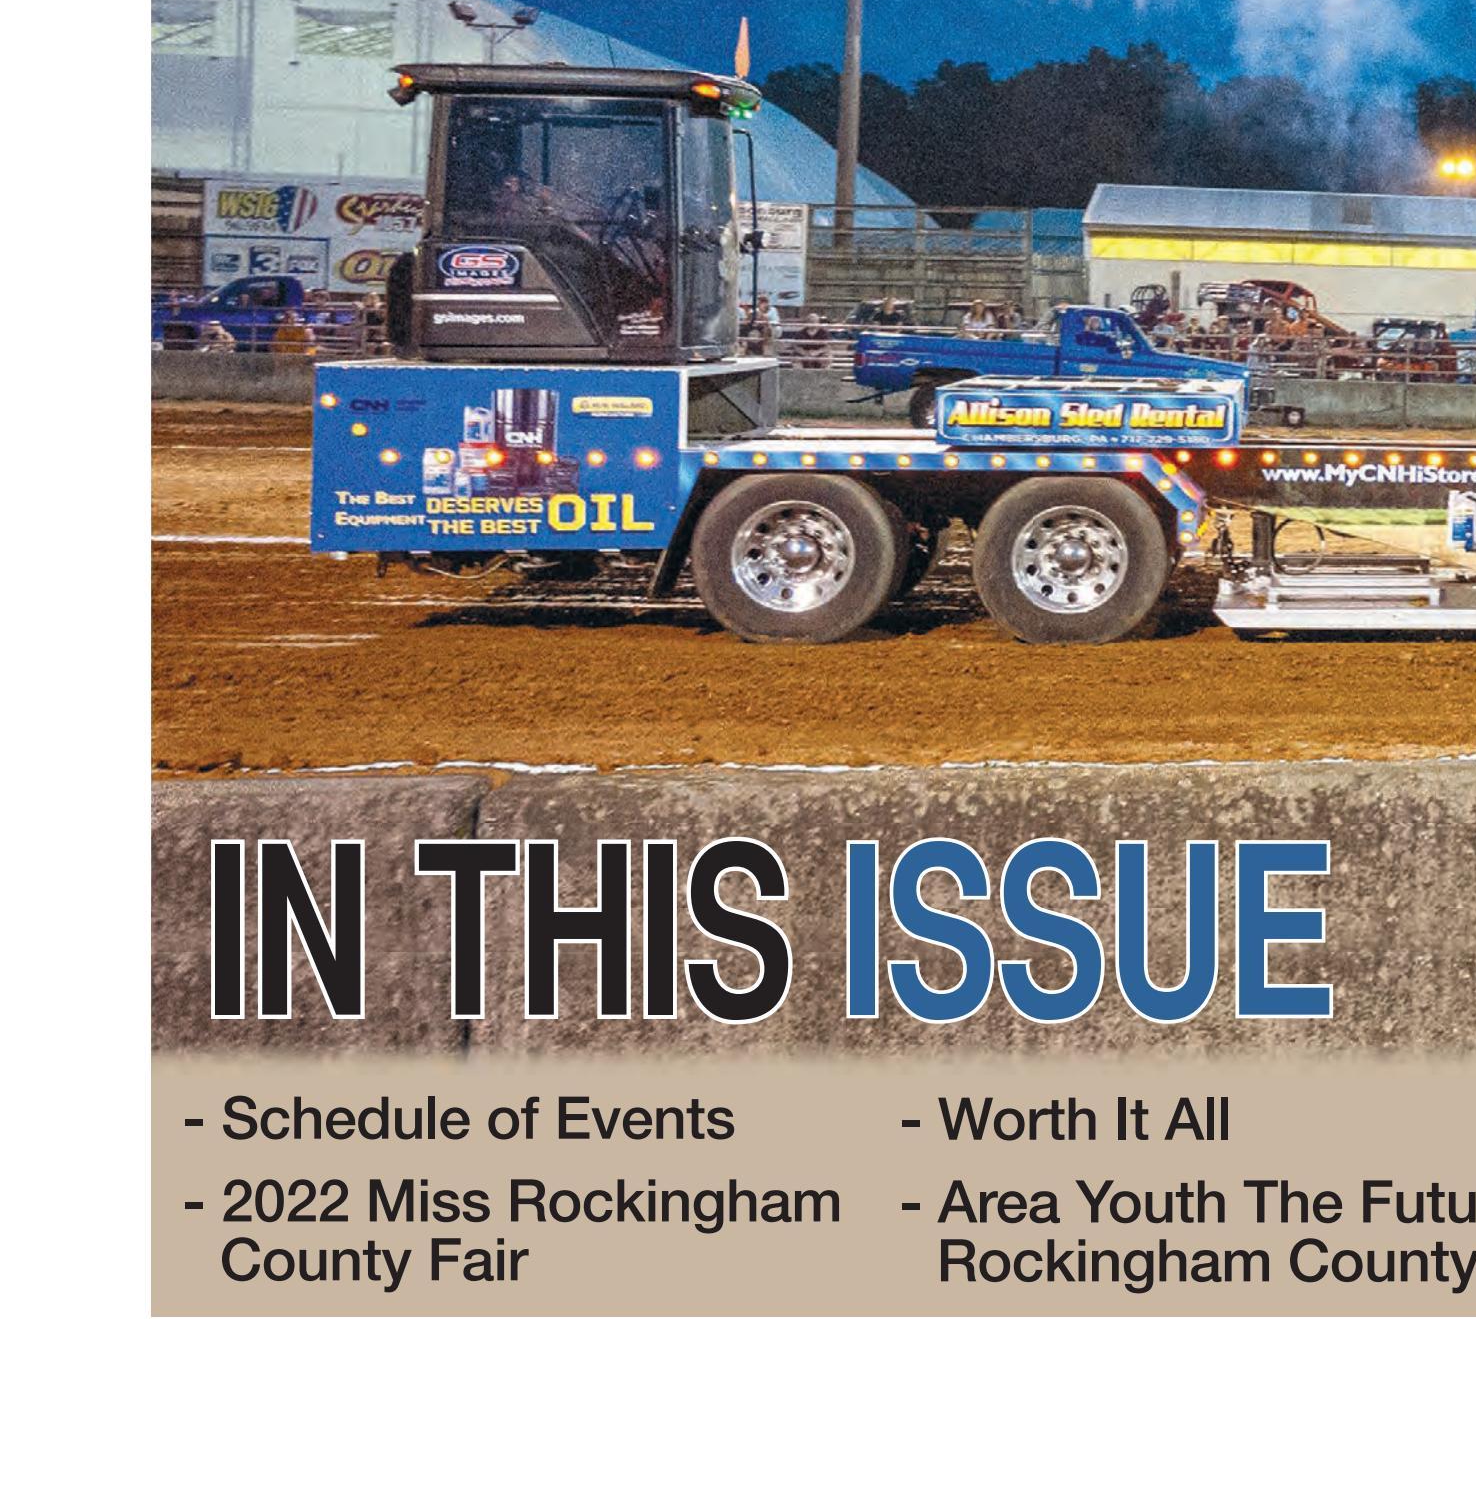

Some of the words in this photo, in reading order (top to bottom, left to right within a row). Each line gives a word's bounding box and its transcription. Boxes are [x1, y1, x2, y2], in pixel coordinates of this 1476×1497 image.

[432, 312, 525, 324] gsimages.com
[947, 399, 1051, 428] Allison
[1057, 403, 1124, 428] Sled
[1128, 403, 1226, 429] Rental
[426, 496, 544, 514] DESERVES
[547, 493, 656, 532] OIL
[428, 519, 475, 535] THE
[479, 519, 543, 535] BEST
